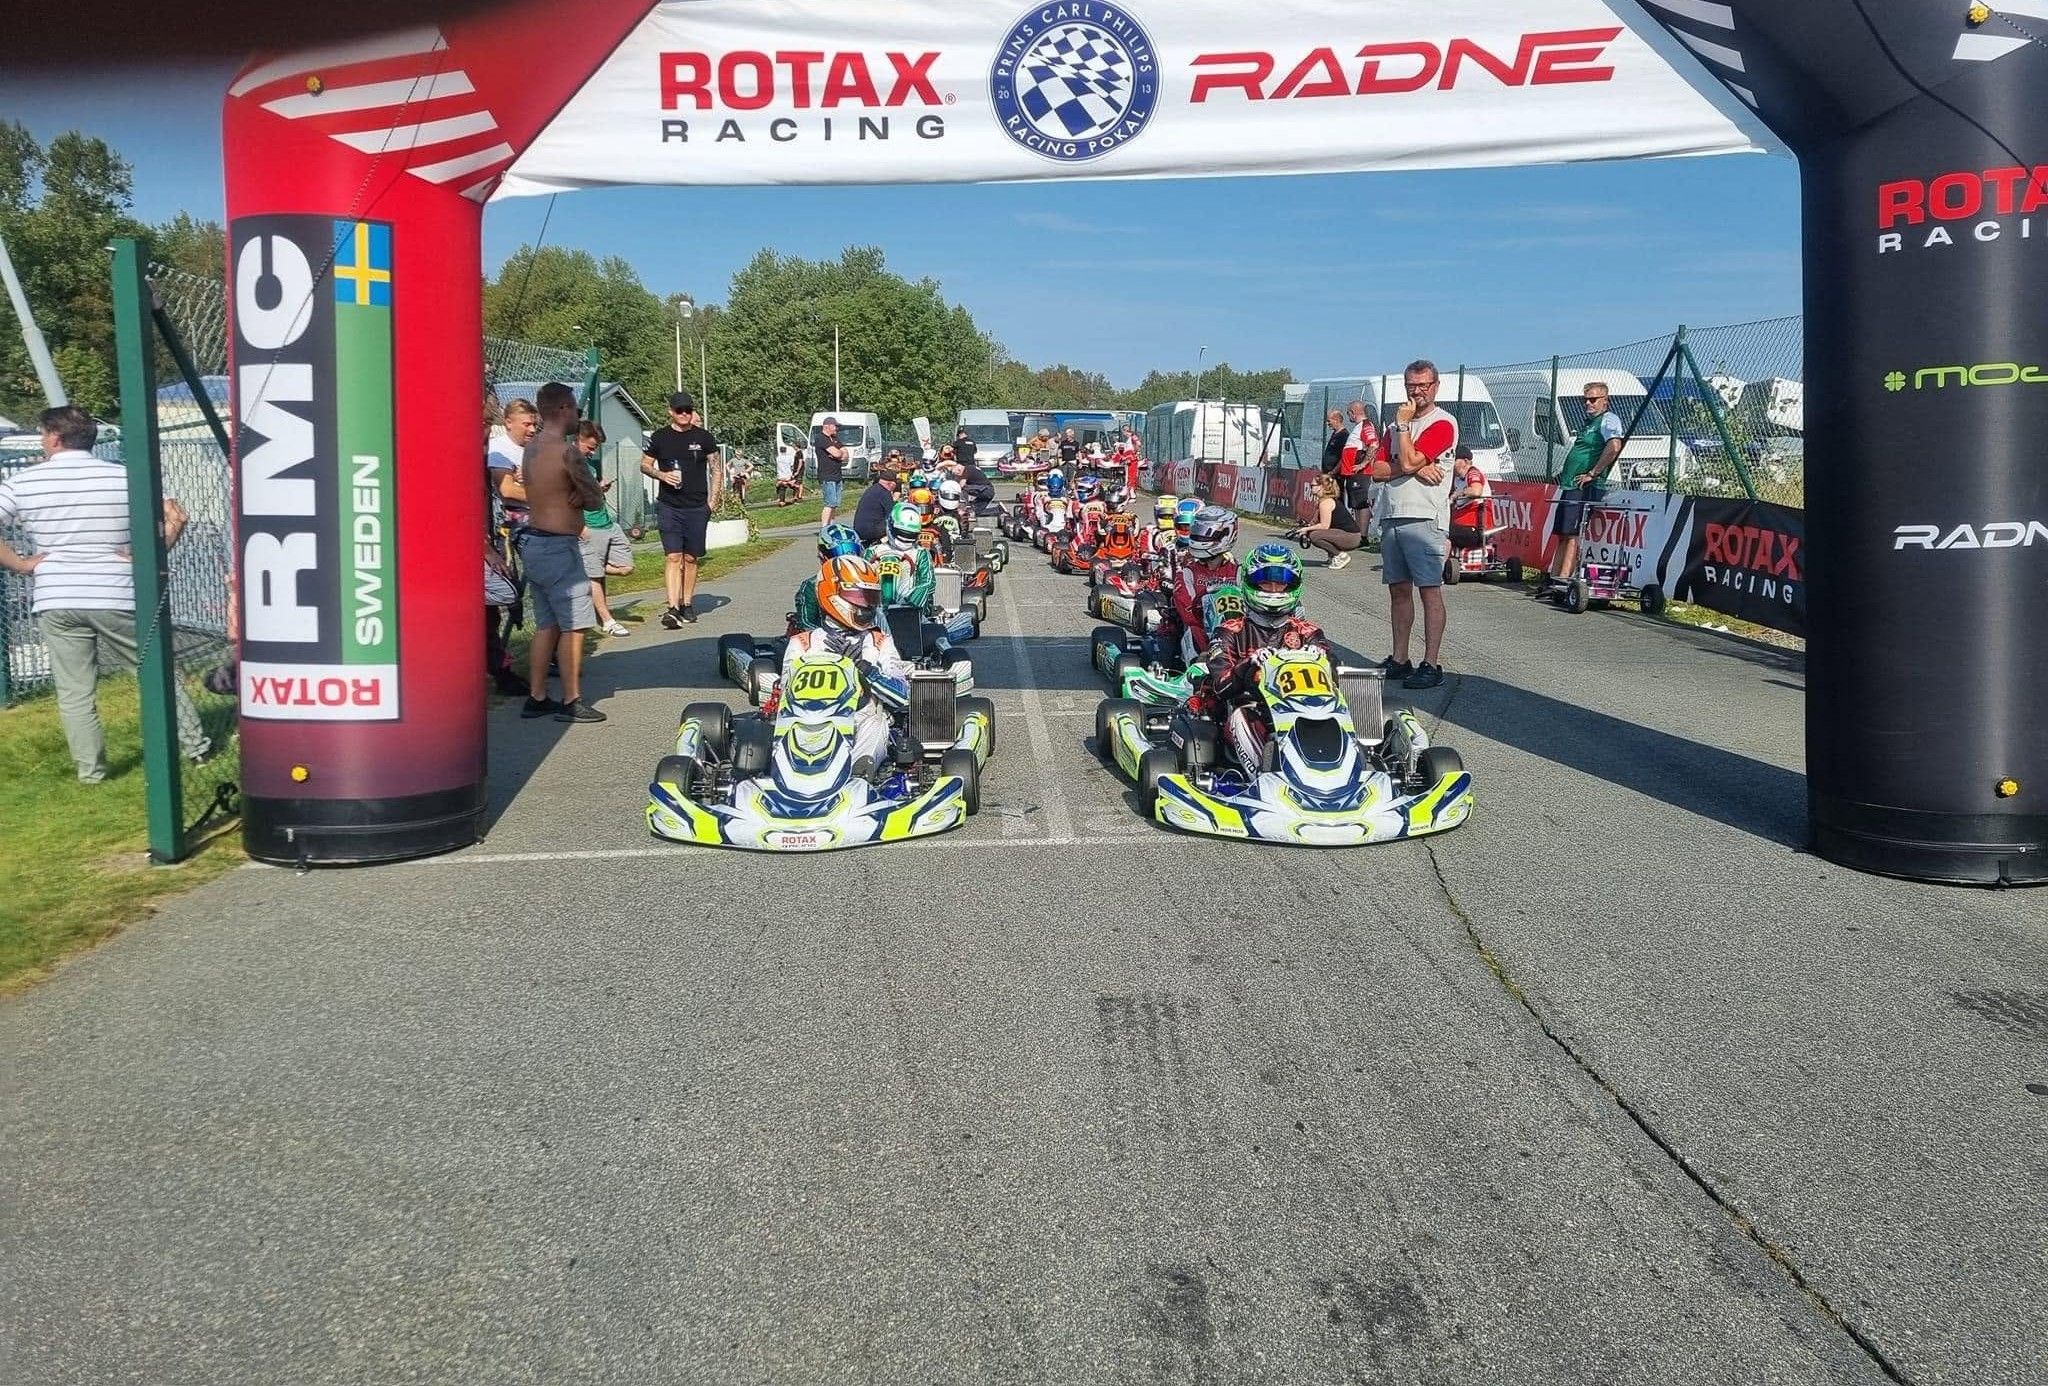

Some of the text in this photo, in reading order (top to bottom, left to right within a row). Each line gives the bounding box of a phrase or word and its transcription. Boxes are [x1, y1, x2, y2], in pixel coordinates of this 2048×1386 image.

[997, 3, 1152, 77] PRINS CARL PHILIPS
[1189, 26, 1625, 103] RADNE
[997, 90, 1010, 100] 20
[1142, 84, 1152, 94] 13
[661, 115, 945, 143] RACING
[1006, 110, 1146, 157] RACING POKAL
[1879, 218, 2048, 254] RACI
[236, 235, 320, 643] RMC
[1491, 498, 1532, 531] OTAX
[351, 455, 383, 646] SWEDEN
[1585, 546, 1643, 569] ACING
[1703, 523, 1801, 582] ROTAX
[1704, 565, 1794, 604] RACING
[1216, 596, 1244, 614] 35
[250, 675, 381, 706] ROTAX
[794, 669, 838, 693] 301
[1279, 668, 1331, 694] 314
[781, 835, 817, 844] ROTAX
